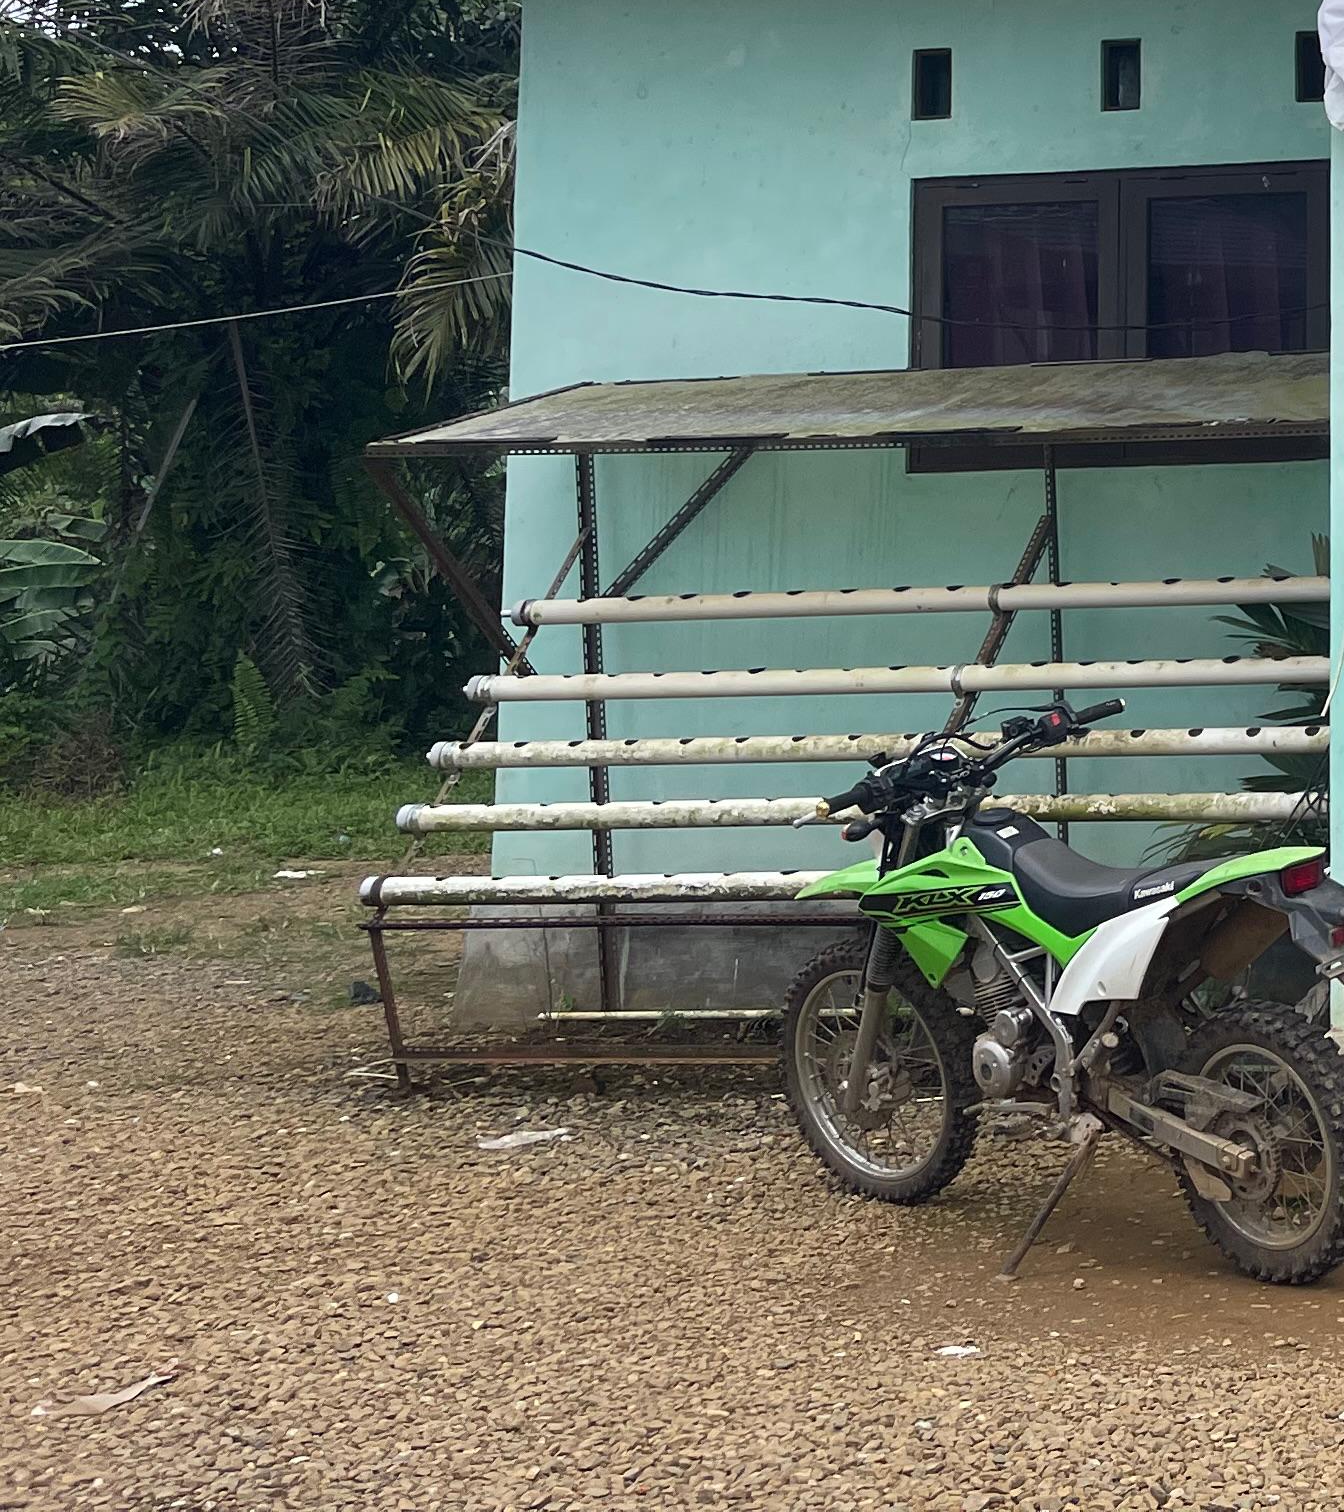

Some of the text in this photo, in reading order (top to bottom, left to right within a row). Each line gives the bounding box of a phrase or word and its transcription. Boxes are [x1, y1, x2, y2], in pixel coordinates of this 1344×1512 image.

[893, 886, 1006, 913] KLX 150
[1134, 880, 1175, 900] Kawasaki
